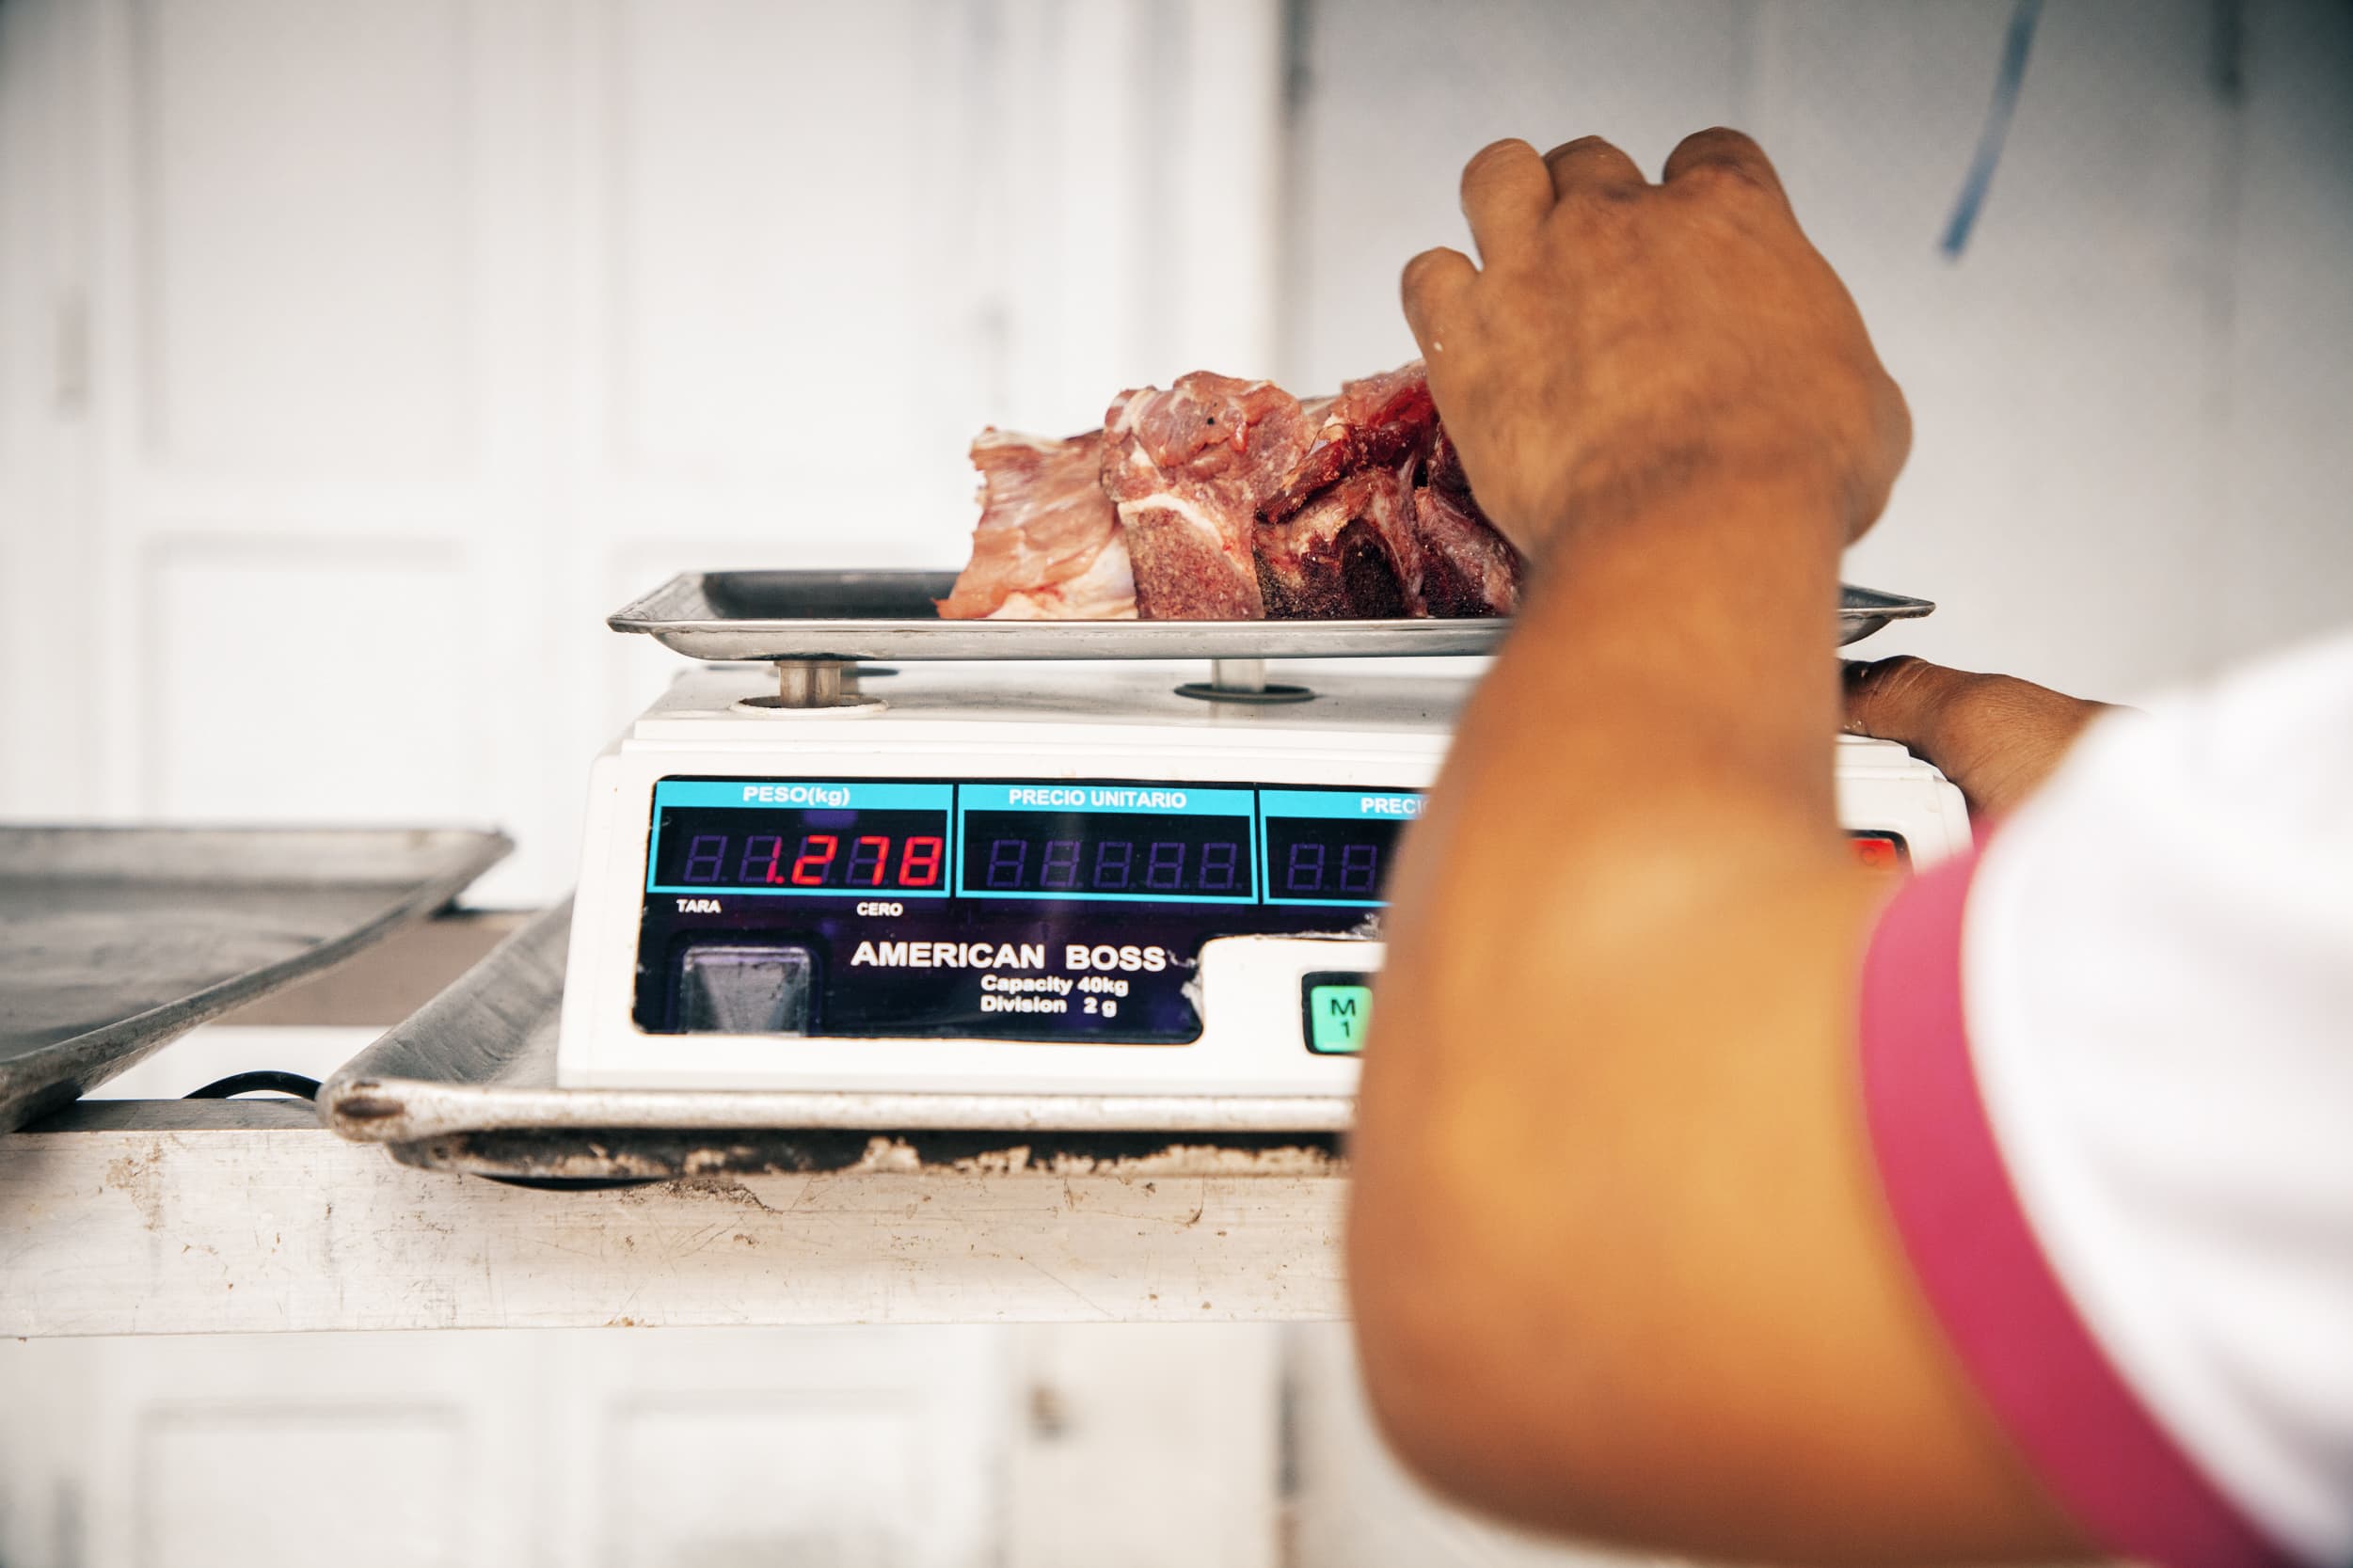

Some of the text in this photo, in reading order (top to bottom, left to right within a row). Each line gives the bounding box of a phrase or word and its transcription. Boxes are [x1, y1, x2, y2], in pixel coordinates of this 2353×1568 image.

[742, 786, 851, 806] PESO(kg)
[1009, 789, 1187, 808] PRECIO UNITARIO
[767, 834, 943, 886] 1.278
[676, 899, 722, 913] TARA
[856, 902, 903, 916] CERO
[851, 941, 1167, 971] AMERICAN BOSS
[980, 975, 1129, 997] Capacity 40kg
[980, 995, 1117, 1018] Division 2 g
[1331, 999, 1356, 1016] M
[1341, 1021, 1350, 1037] 1
